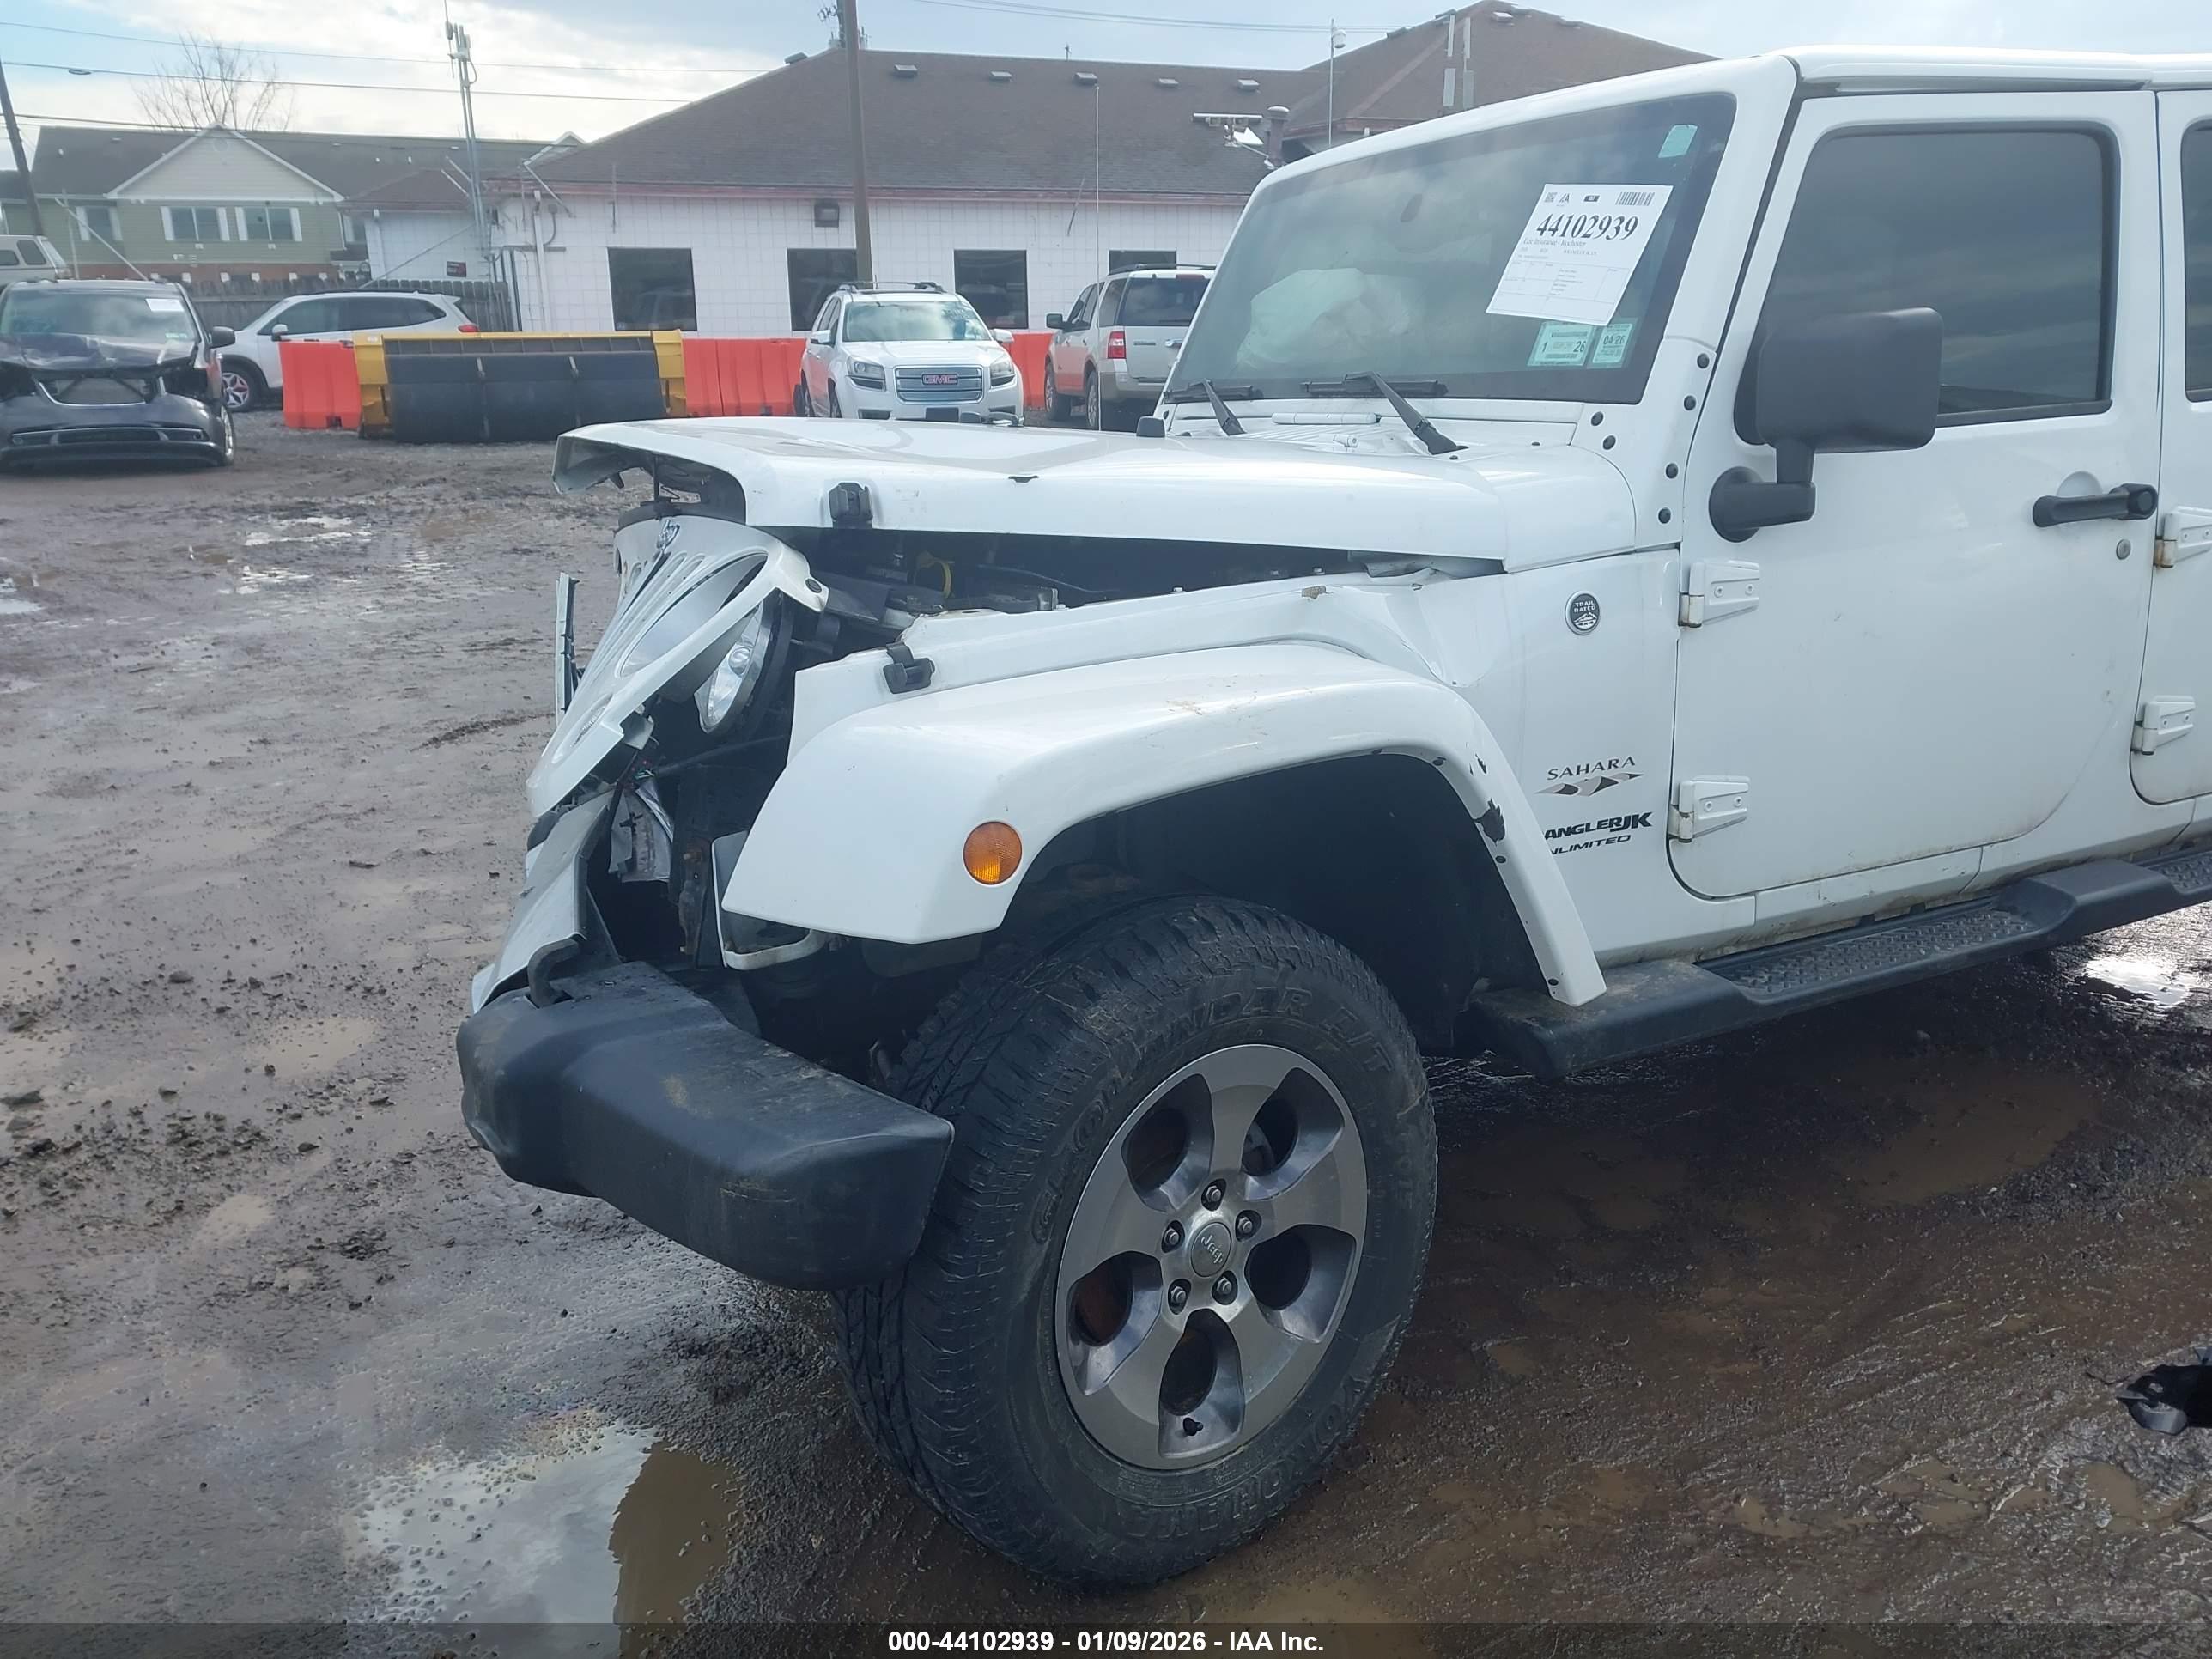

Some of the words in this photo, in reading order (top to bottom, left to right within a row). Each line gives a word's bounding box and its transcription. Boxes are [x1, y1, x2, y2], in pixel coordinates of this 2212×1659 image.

[1536, 213, 1638, 240] 44102939
[1573, 340, 1587, 352] 26
[922, 374, 957, 385] GMC
[1547, 756, 1636, 781] SAHARA
[1200, 1235, 1224, 1264] Jeep
